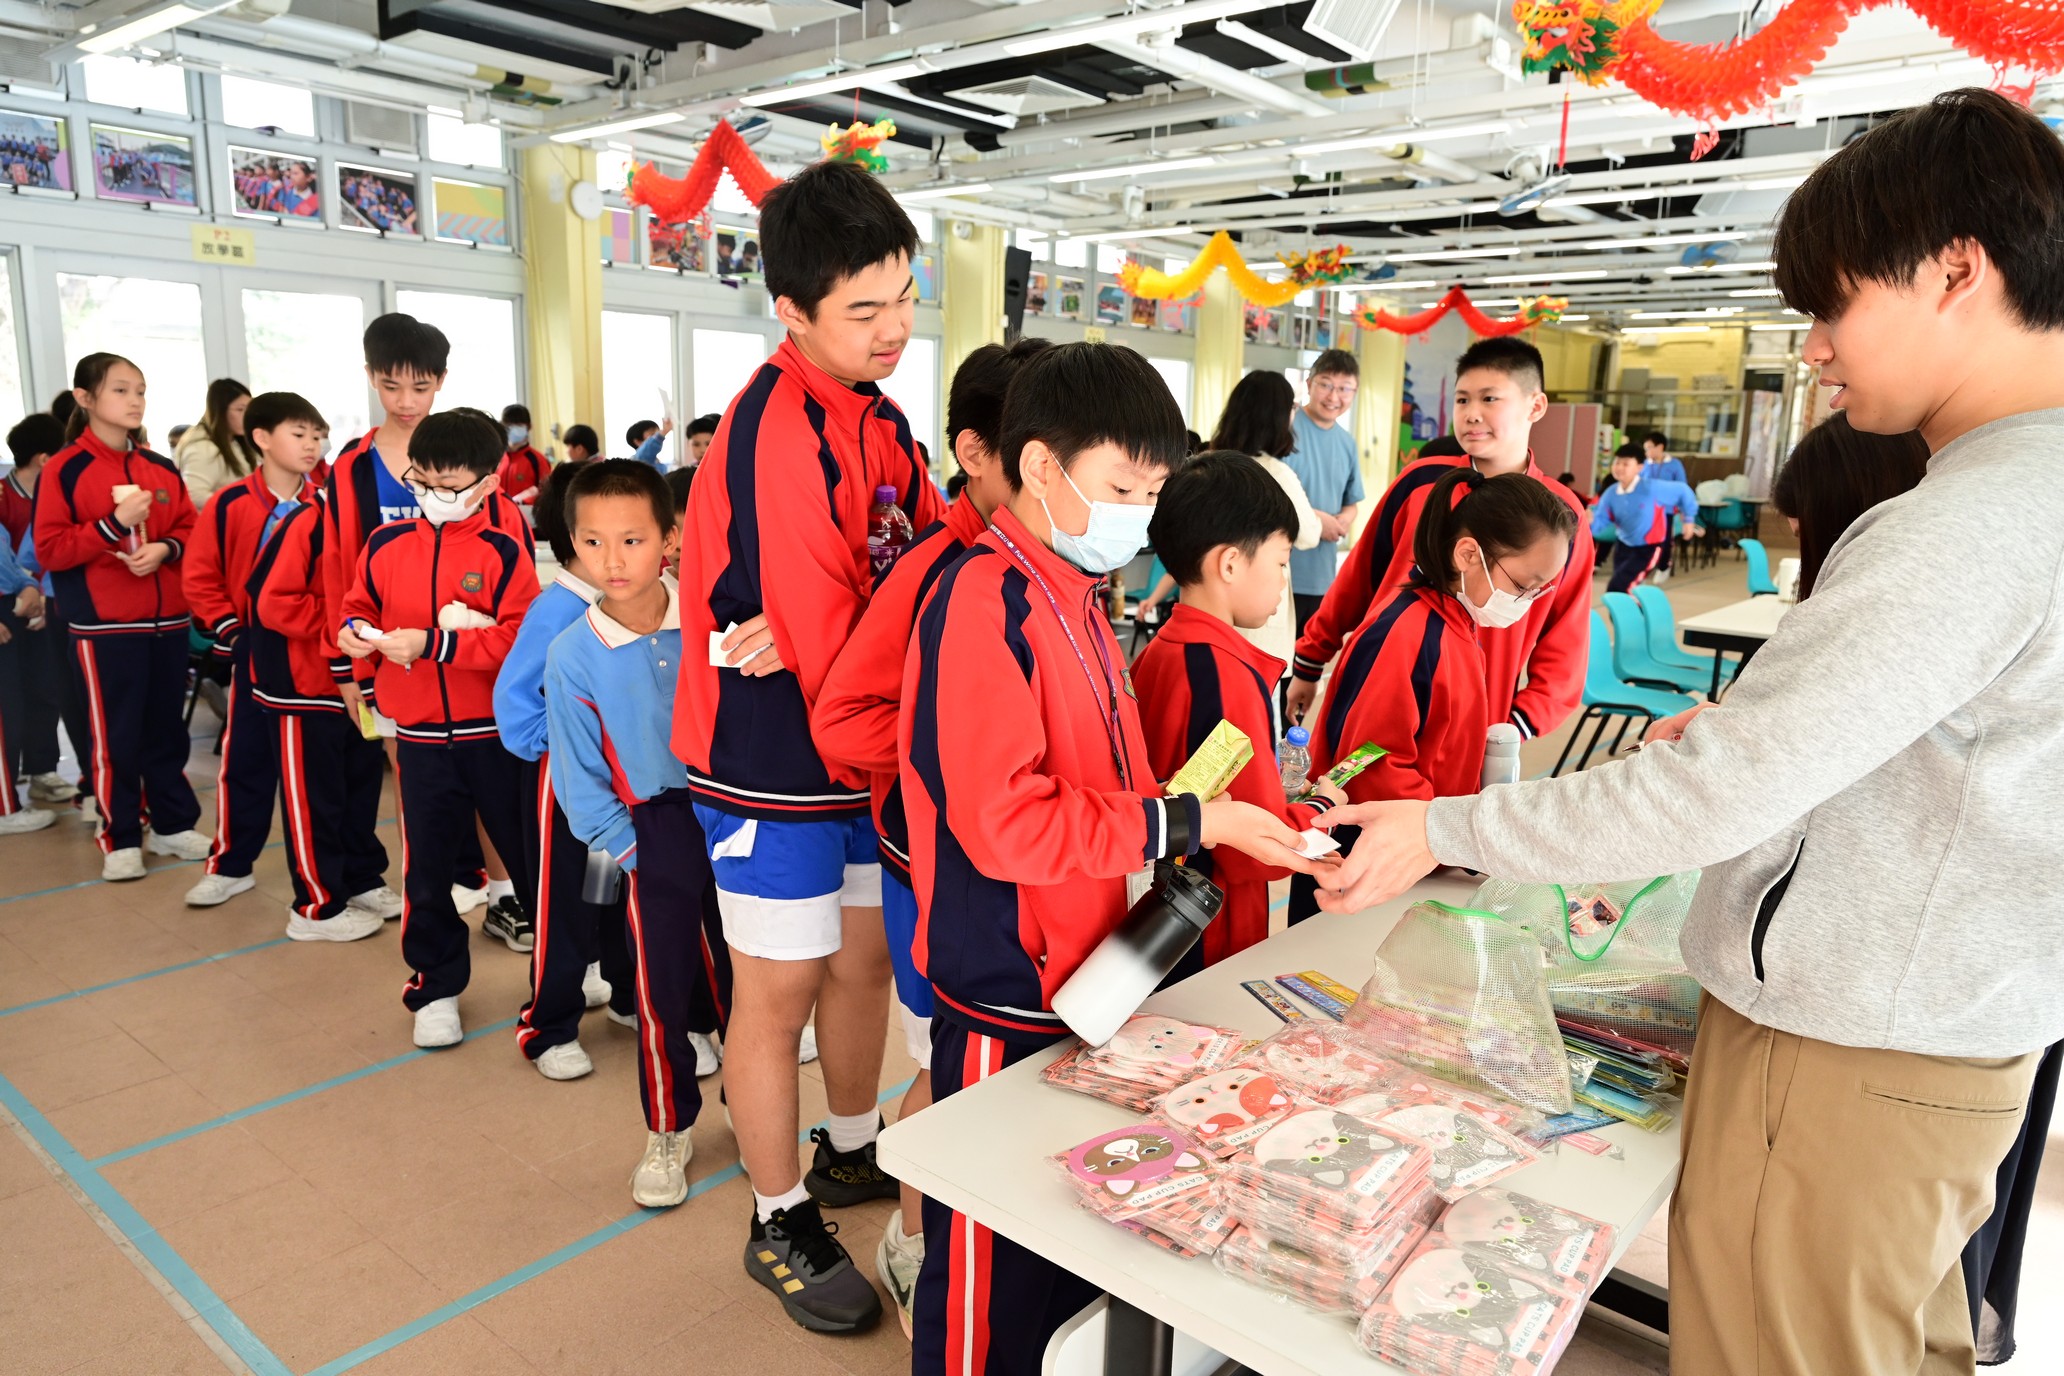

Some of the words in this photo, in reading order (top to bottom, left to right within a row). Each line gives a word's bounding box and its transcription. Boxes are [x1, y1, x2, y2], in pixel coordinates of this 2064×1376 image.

[202, 243, 244, 258] 放學區
[1014, 549, 1025, 561] Fuk
[1023, 559, 1036, 575] Wing
[1251, 1125, 1270, 1135] CUP
[1230, 1133, 1249, 1143] PAD
[1374, 1165, 1388, 1179] CUP
[1472, 1167, 1488, 1176] CUP
[1177, 1176, 1203, 1187] CATS
[1360, 1178, 1376, 1192] PAD
[1155, 1185, 1175, 1196] CUP
[1132, 1194, 1153, 1205] PAD
[1206, 1214, 1220, 1228] PAD
[1568, 1245, 1579, 1259] CUP
[1560, 1259, 1572, 1273] PAD
[1530, 1301, 1548, 1322] CATS
[1522, 1321, 1536, 1337] CUP
[1511, 1337, 1526, 1353] PAD
